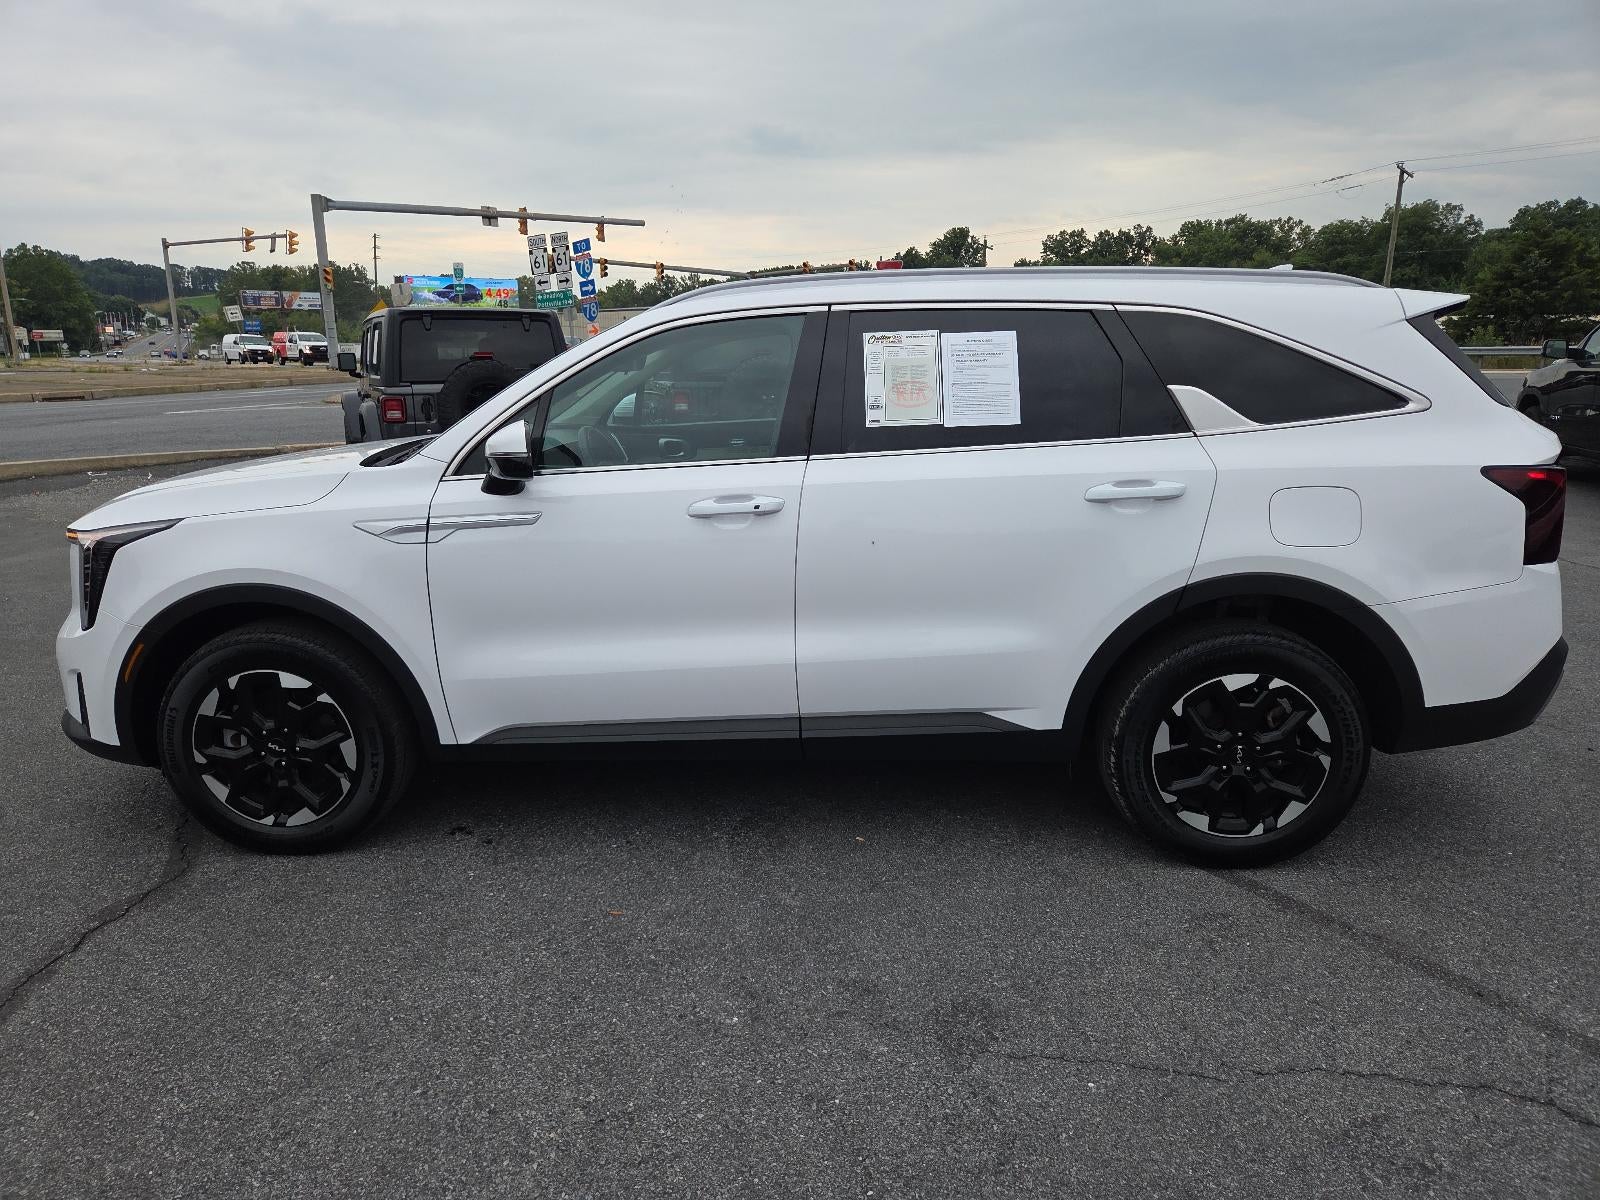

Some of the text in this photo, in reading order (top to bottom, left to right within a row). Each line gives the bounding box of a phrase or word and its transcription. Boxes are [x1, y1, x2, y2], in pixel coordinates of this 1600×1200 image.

[528, 238, 546, 246] SOUTH
[551, 235, 568, 244] NORTH
[576, 242, 586, 251] TO
[534, 254, 546, 269] 61
[556, 251, 568, 266] 61
[578, 258, 591, 275] 78
[583, 303, 597, 319] 78
